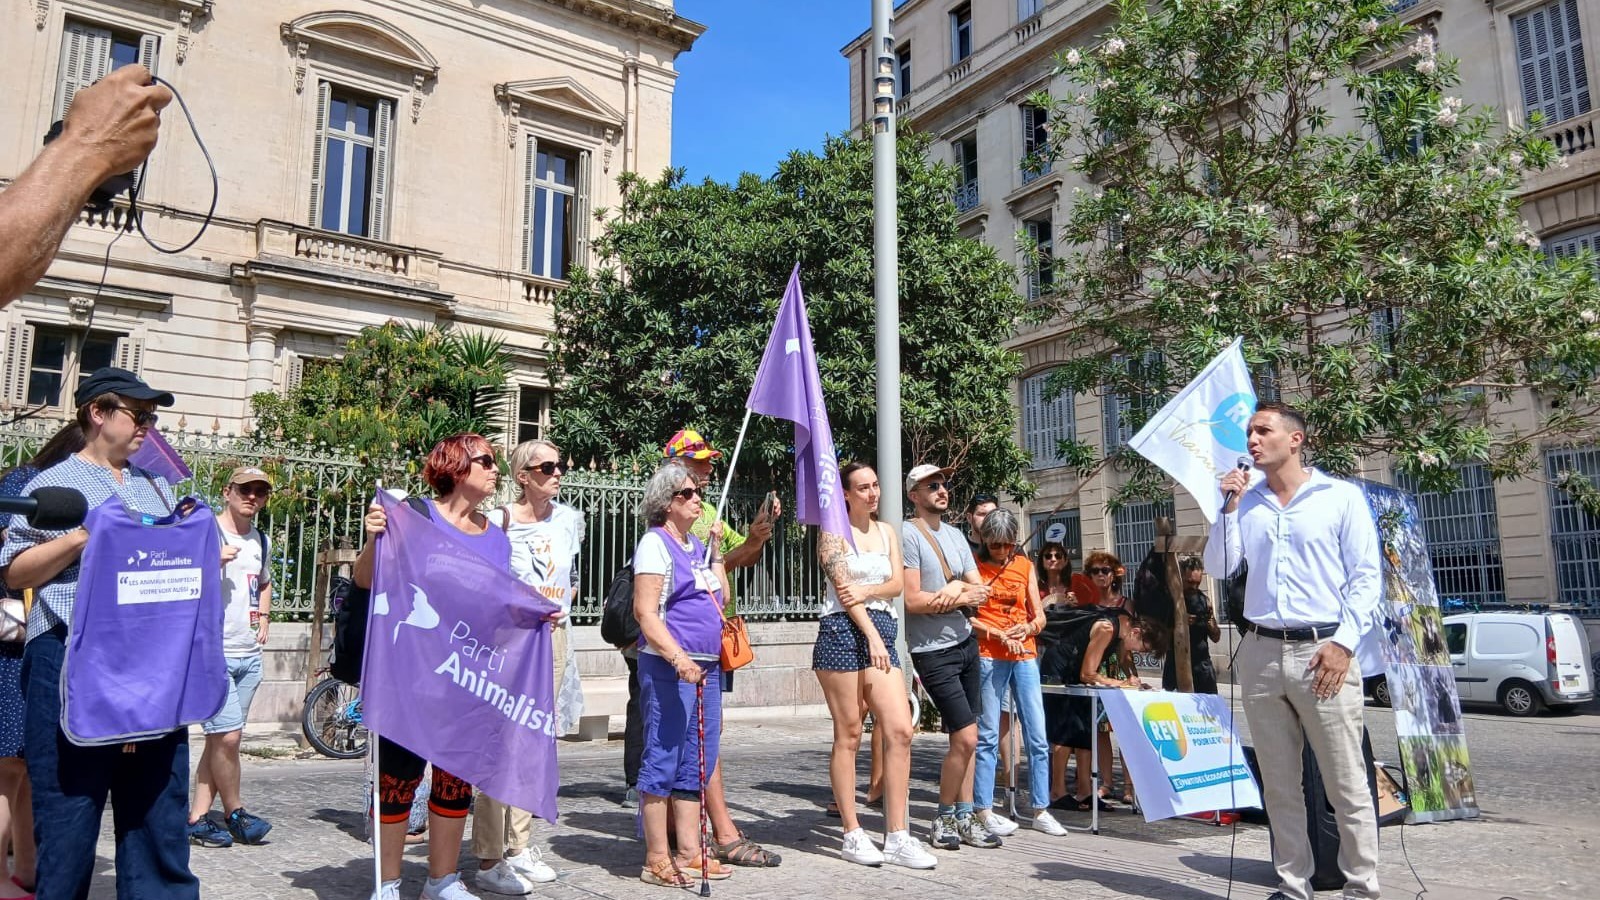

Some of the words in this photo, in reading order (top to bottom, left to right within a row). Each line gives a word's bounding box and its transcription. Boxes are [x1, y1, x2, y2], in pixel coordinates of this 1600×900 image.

[150, 550, 168, 559] Parti
[150, 557, 192, 566] Animaliste
[449, 620, 508, 673] Parti
[434, 651, 555, 744] Animalist
[1148, 720, 1180, 741] REV
